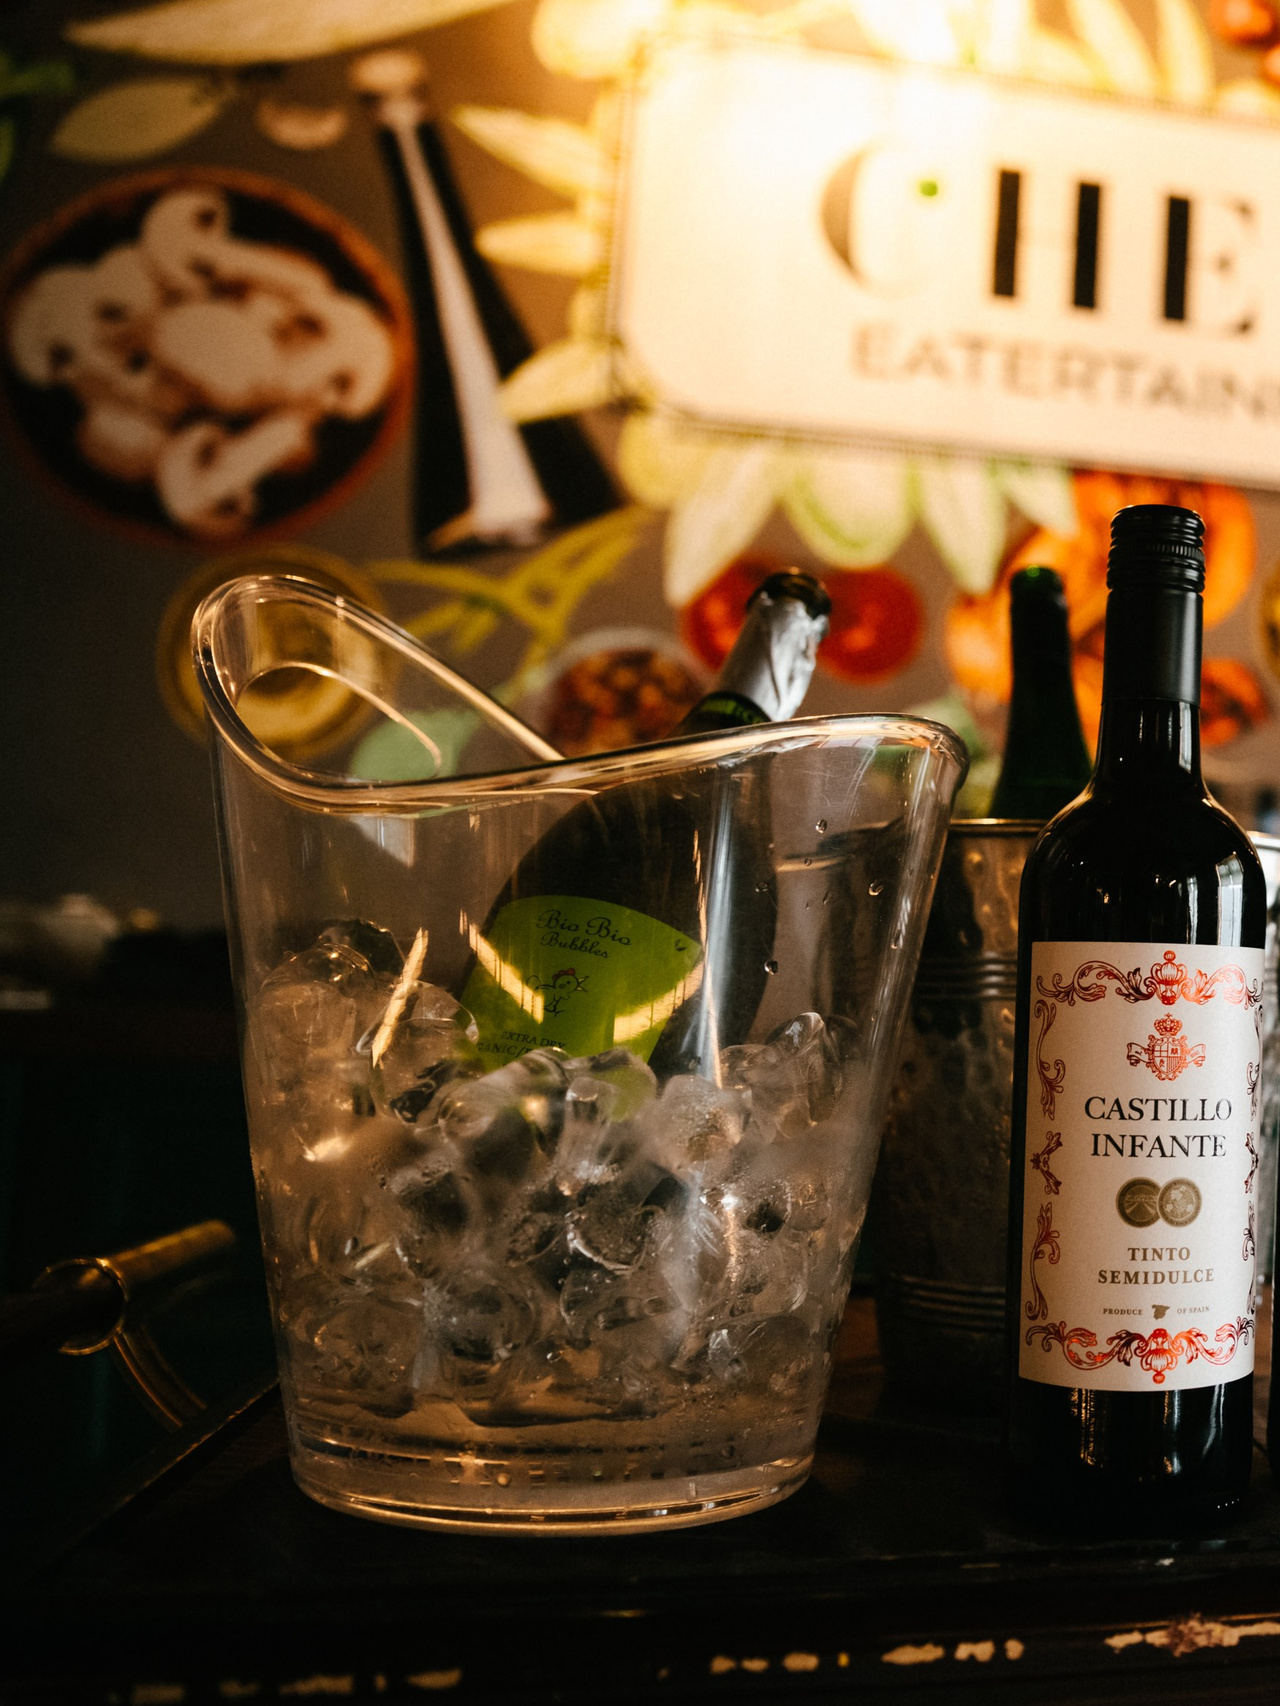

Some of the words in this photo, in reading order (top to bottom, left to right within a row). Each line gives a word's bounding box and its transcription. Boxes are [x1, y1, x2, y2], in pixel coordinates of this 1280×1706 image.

[536, 909, 580, 932] Bio
[585, 916, 632, 946] Bio
[540, 931, 609, 959] Bubbles
[501, 1031, 537, 1045] EXTRA
[1084, 1096, 1233, 1122] CASTILLO
[1090, 1133, 1227, 1158] INFANTE
[1127, 1247, 1191, 1262] TINTO
[1097, 1268, 1215, 1285] SEMIDULCE
[1103, 1307, 1143, 1316] PRODUCE
[1177, 1307, 1187, 1315] OF
[1189, 1306, 1210, 1314] SPAIN
